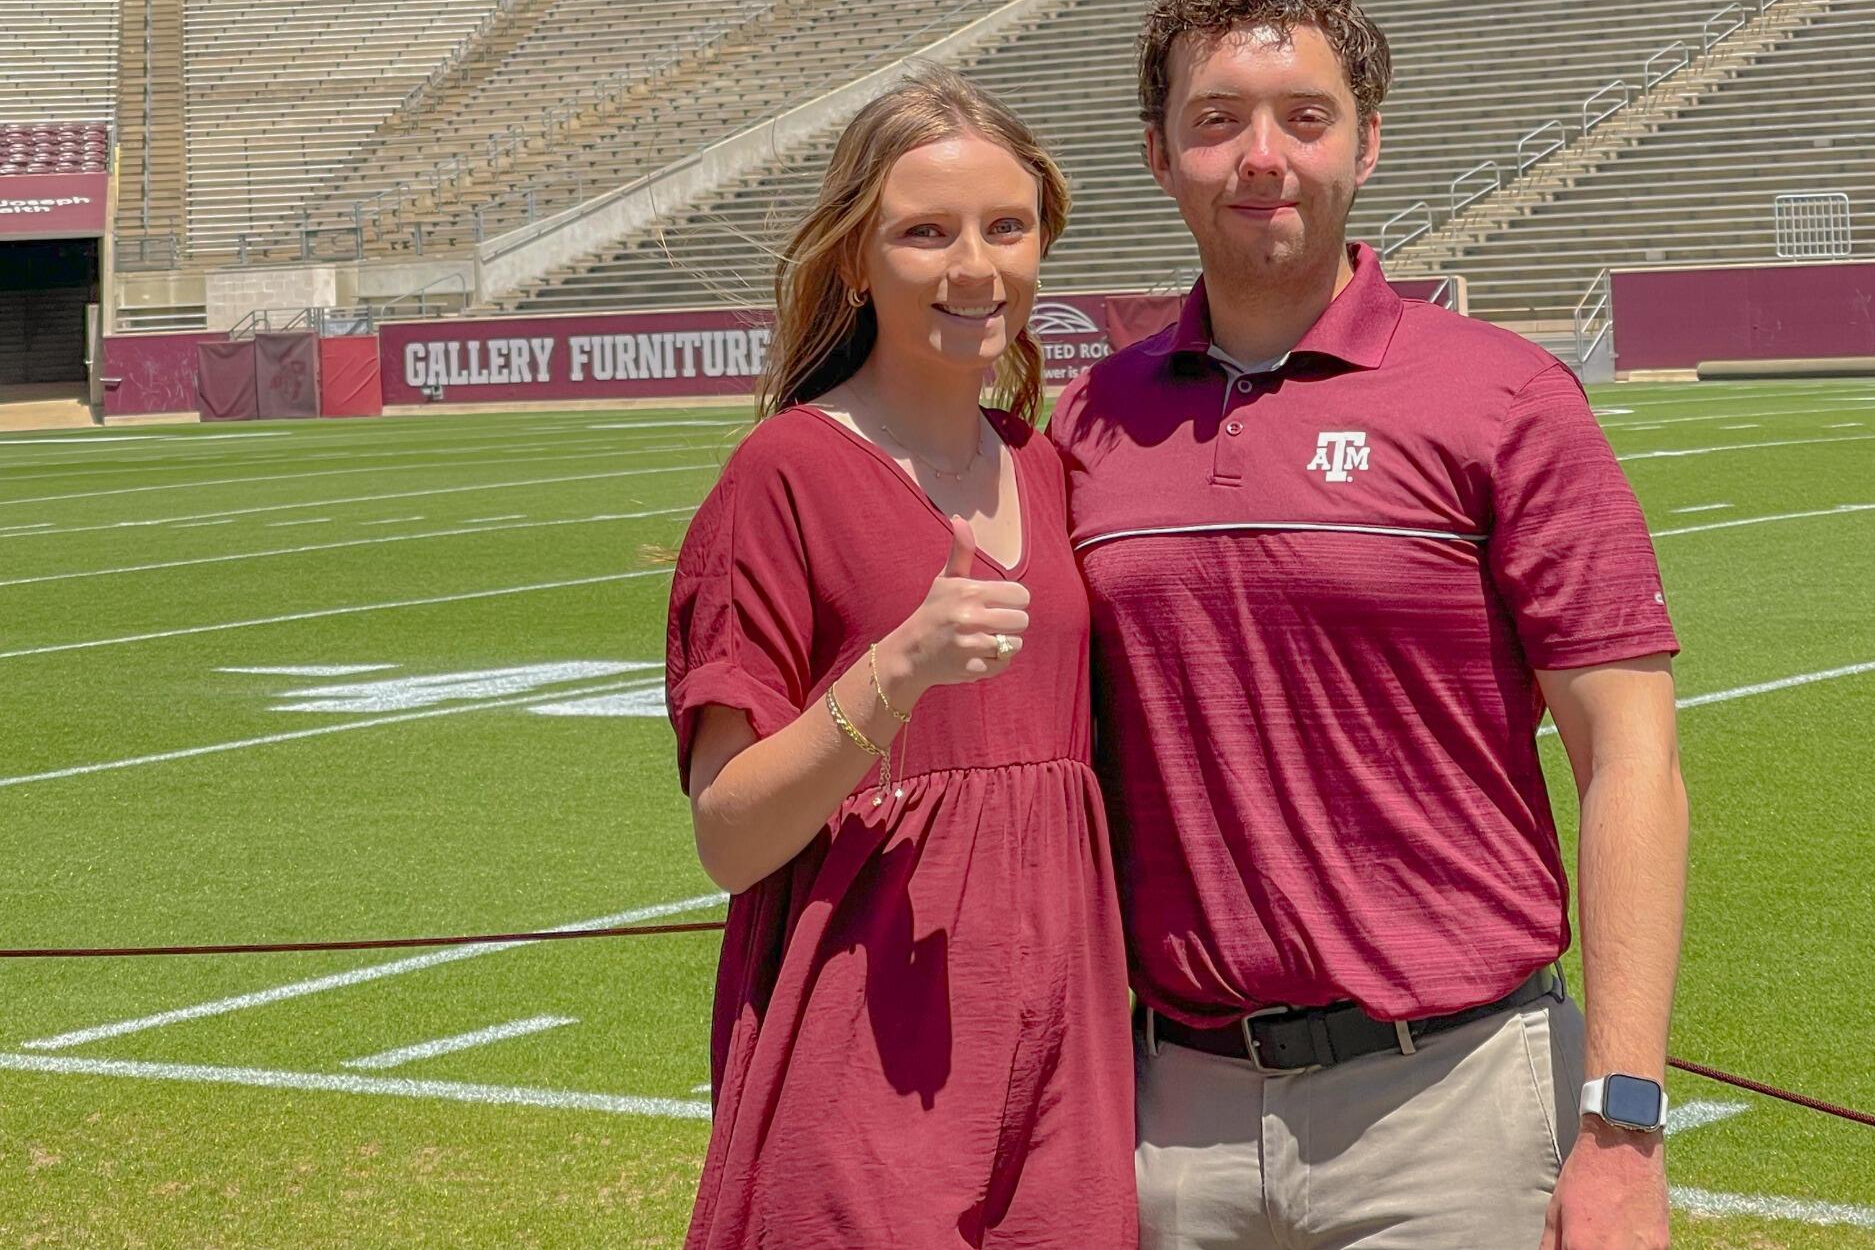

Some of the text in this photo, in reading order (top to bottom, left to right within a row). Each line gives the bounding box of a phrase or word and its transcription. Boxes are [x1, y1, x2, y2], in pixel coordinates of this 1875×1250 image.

[405, 329, 770, 388] GALLERY FURNITURE
[1043, 343, 1076, 360] TED
